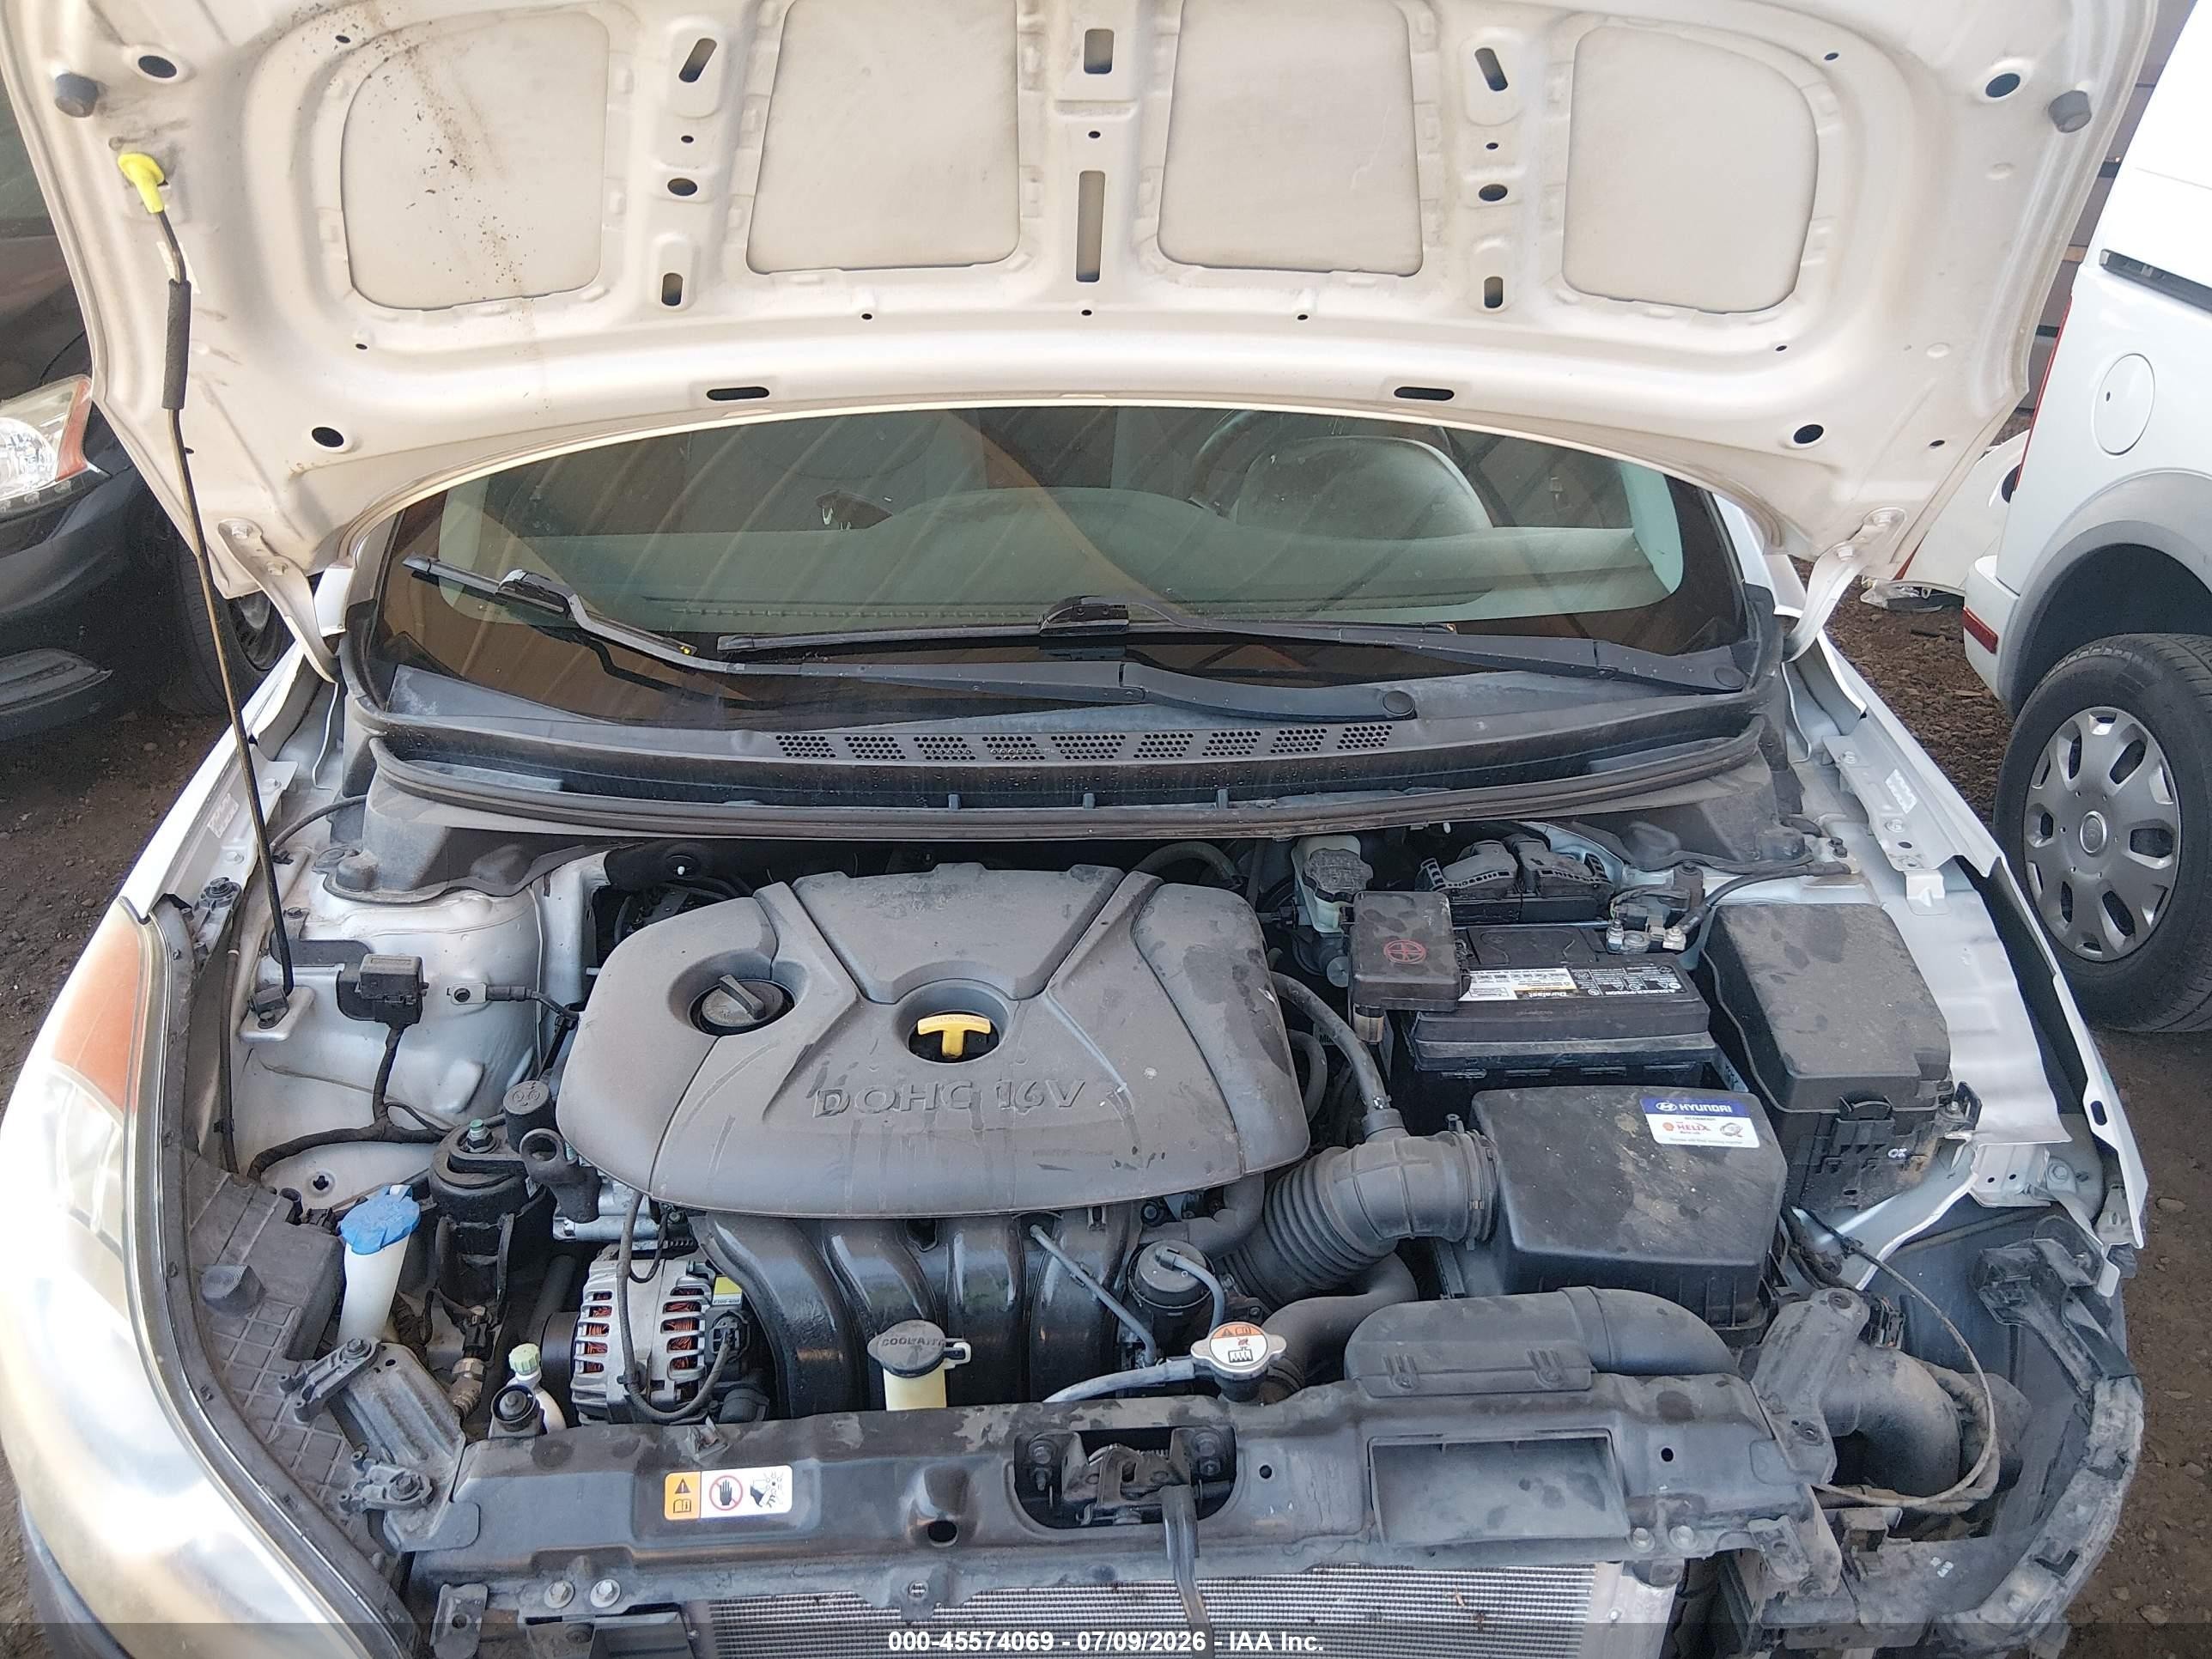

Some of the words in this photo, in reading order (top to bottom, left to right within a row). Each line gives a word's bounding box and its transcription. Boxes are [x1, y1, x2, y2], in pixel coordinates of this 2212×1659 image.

[813, 1080, 973, 1117] DOHC
[996, 1079, 1085, 1115] 16V
[1679, 1103, 1733, 1114] HYUNDAI
[1676, 1123, 1711, 1132] HELIX
